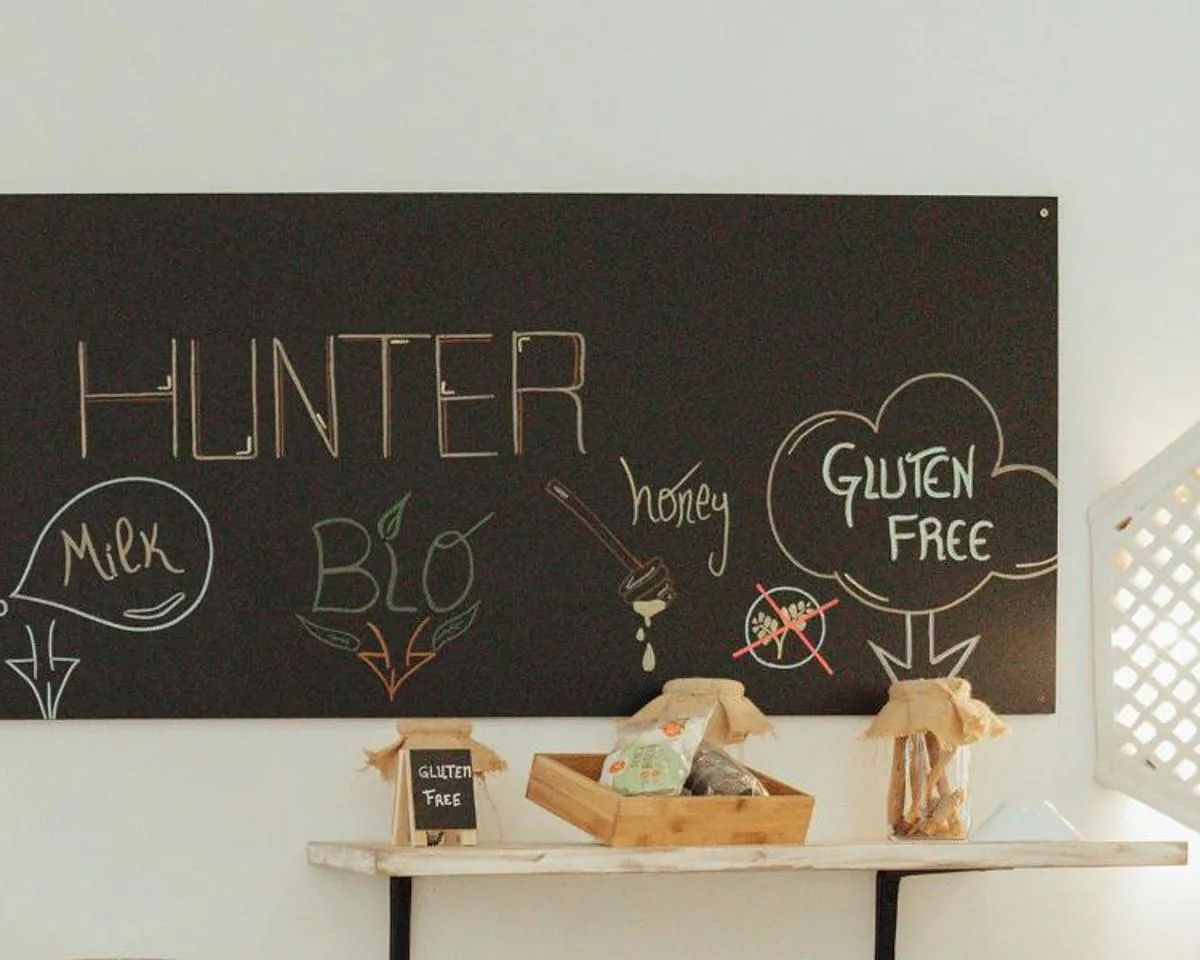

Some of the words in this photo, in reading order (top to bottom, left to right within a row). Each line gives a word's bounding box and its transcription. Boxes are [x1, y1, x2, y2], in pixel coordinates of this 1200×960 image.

[76, 329, 589, 461] HUNTER
[619, 456, 731, 577] honey
[822, 443, 976, 528] GLUTEN
[887, 514, 994, 562] FREE
[422, 788, 462, 808] FREE
